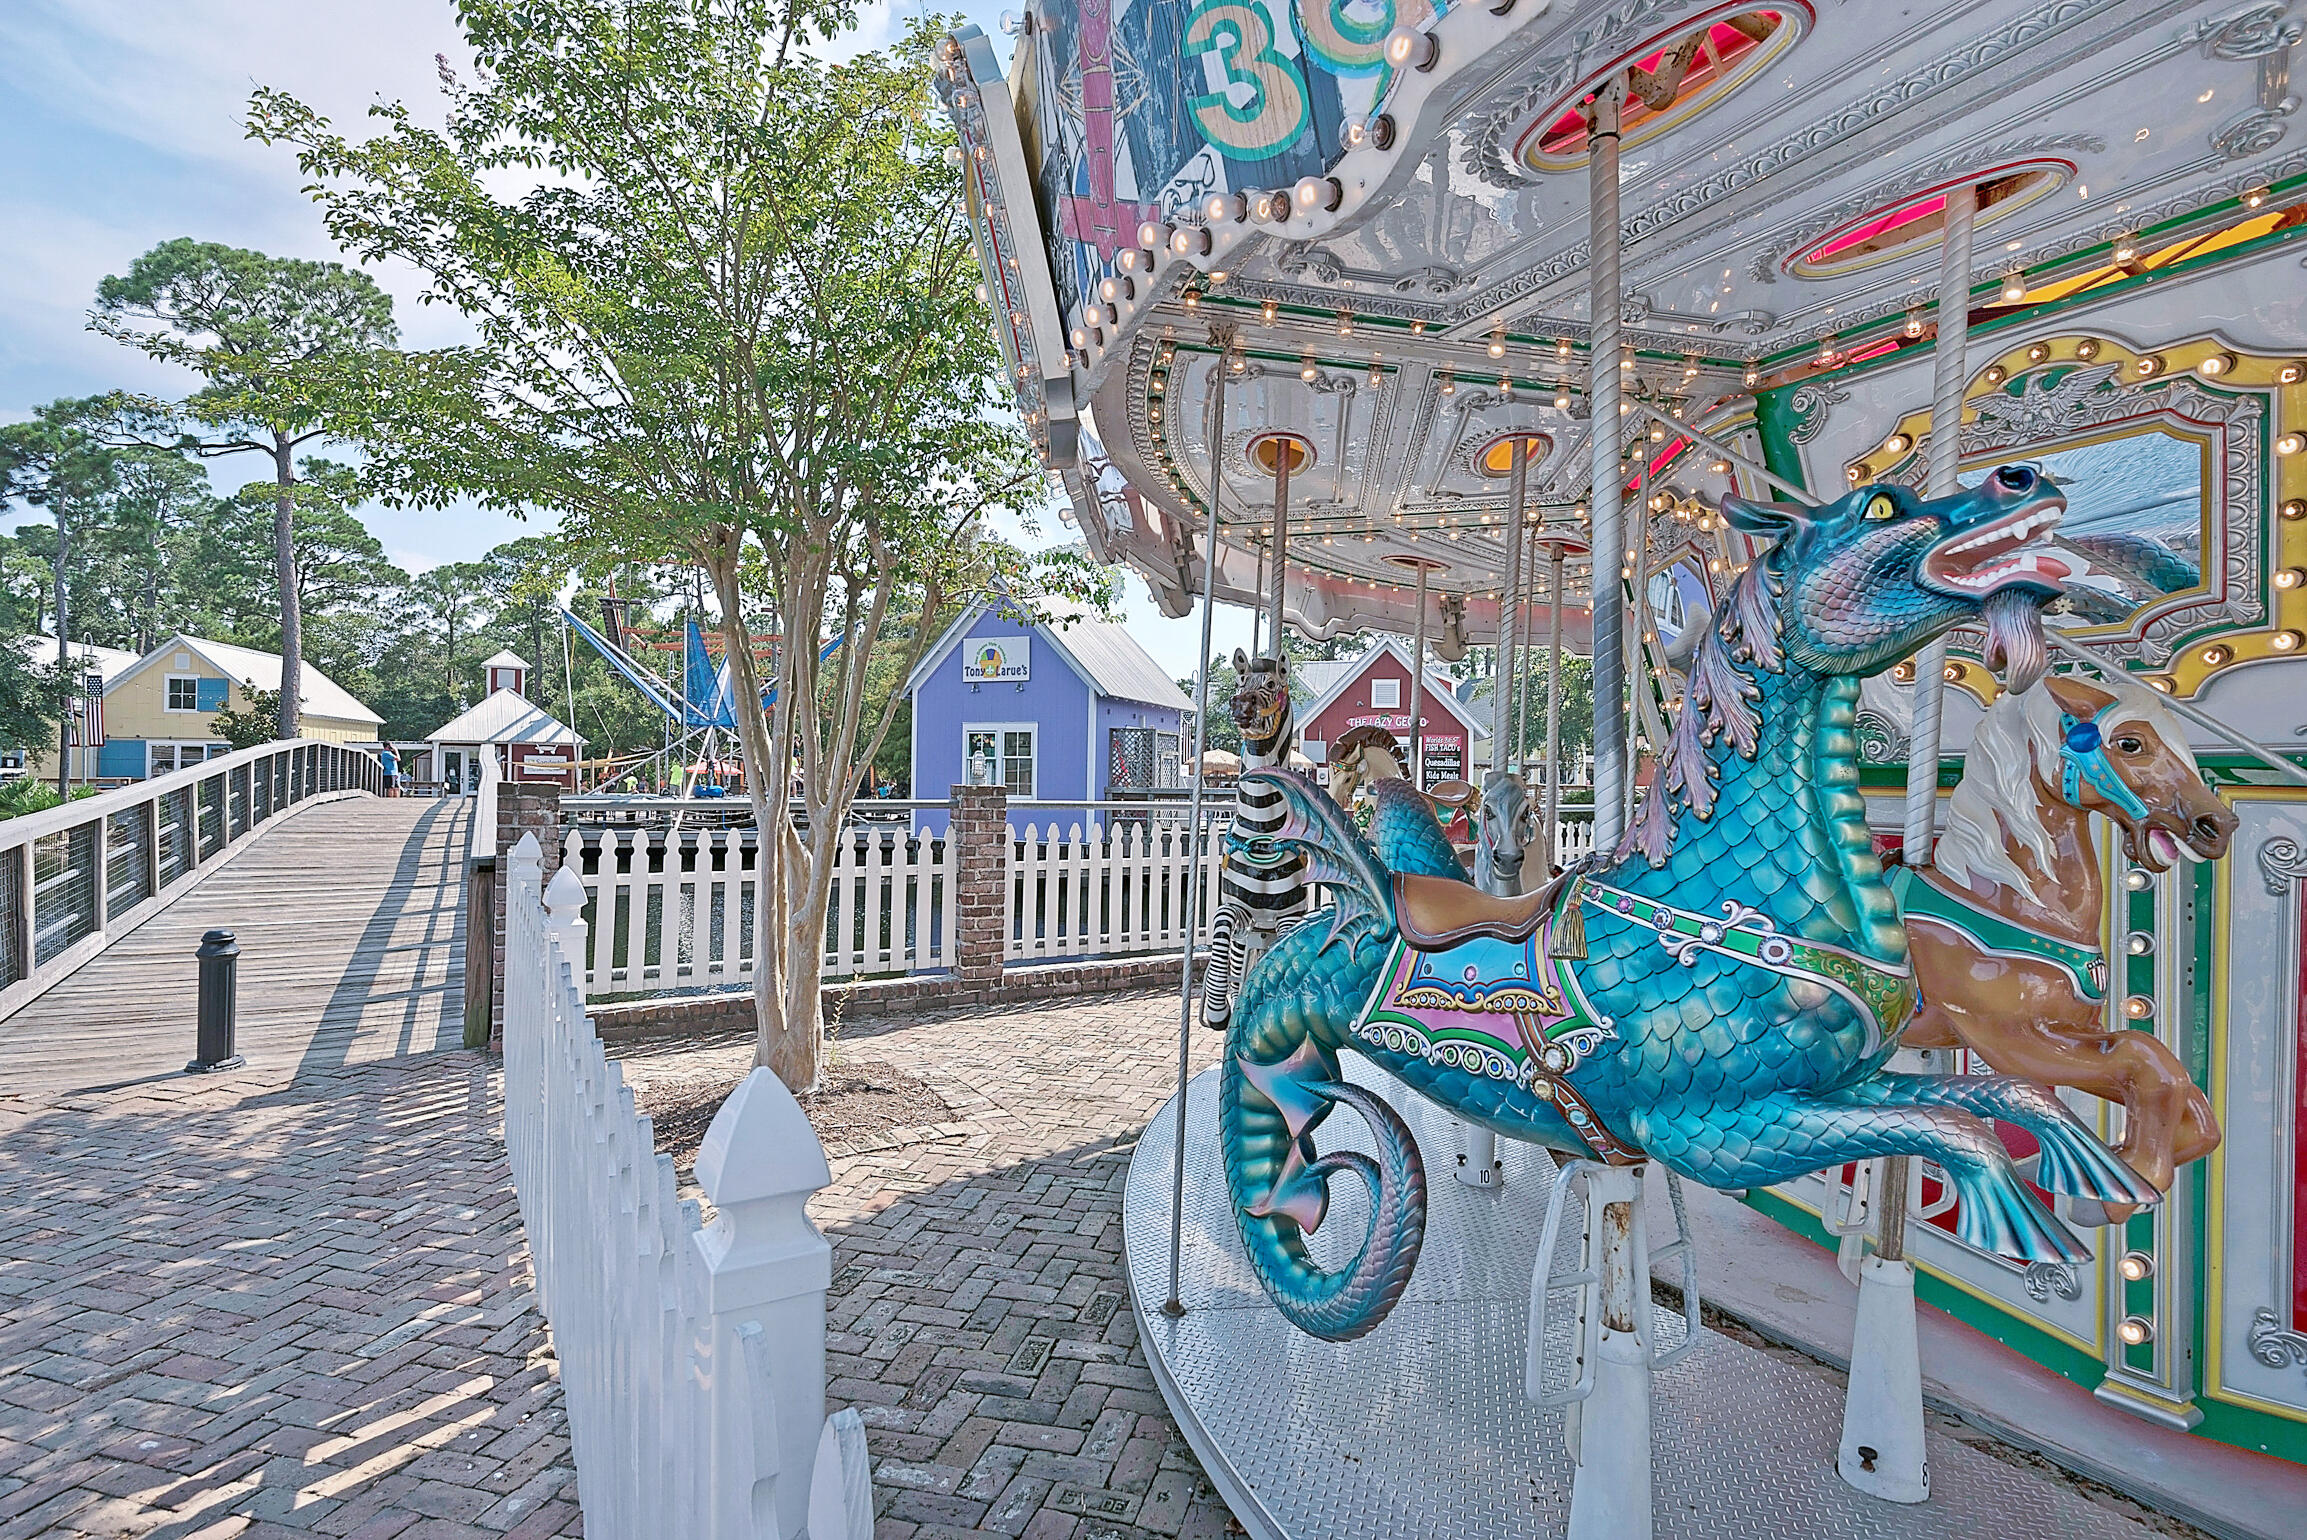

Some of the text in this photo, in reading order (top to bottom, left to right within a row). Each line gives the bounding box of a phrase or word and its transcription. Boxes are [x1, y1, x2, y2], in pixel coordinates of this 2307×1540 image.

[964, 664, 1028, 677] Tony Larue's
[1348, 717, 1367, 727] THE
[1395, 716, 1427, 728] GECO
[1425, 743, 1439, 751] FISH
[1425, 757, 1461, 767] Quesadillas
[1425, 770, 1459, 780] Kids Meals
[1480, 1169, 1490, 1184] 10
[1922, 1462, 1928, 1487] 8
